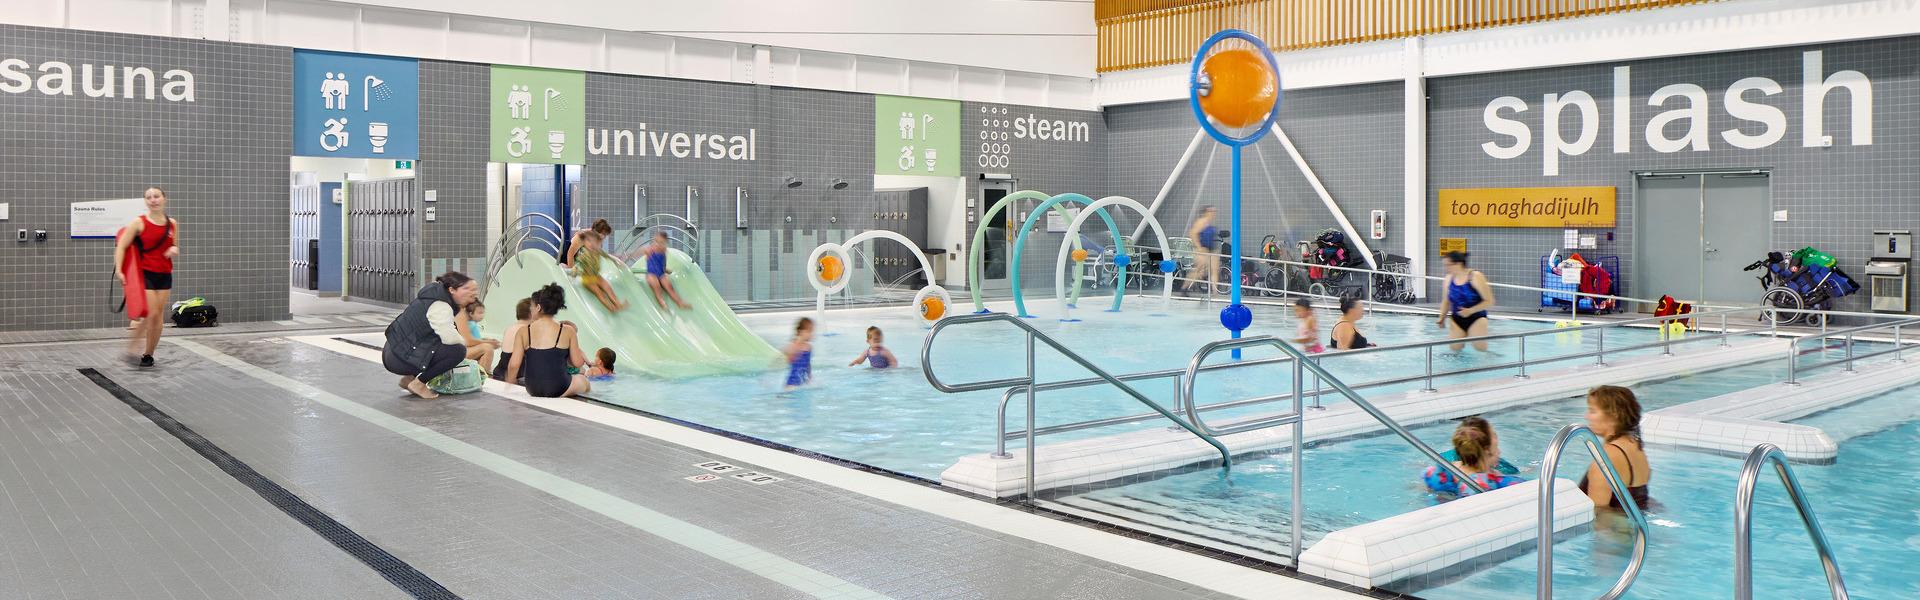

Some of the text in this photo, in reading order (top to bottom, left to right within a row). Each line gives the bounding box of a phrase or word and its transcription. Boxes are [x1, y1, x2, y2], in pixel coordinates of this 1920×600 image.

[0, 58, 195, 102] sauna
[1014, 113, 1089, 142] steam
[1481, 50, 1873, 176] splash
[587, 122, 756, 161] universal
[1451, 197, 1600, 219] too naghadijulh
